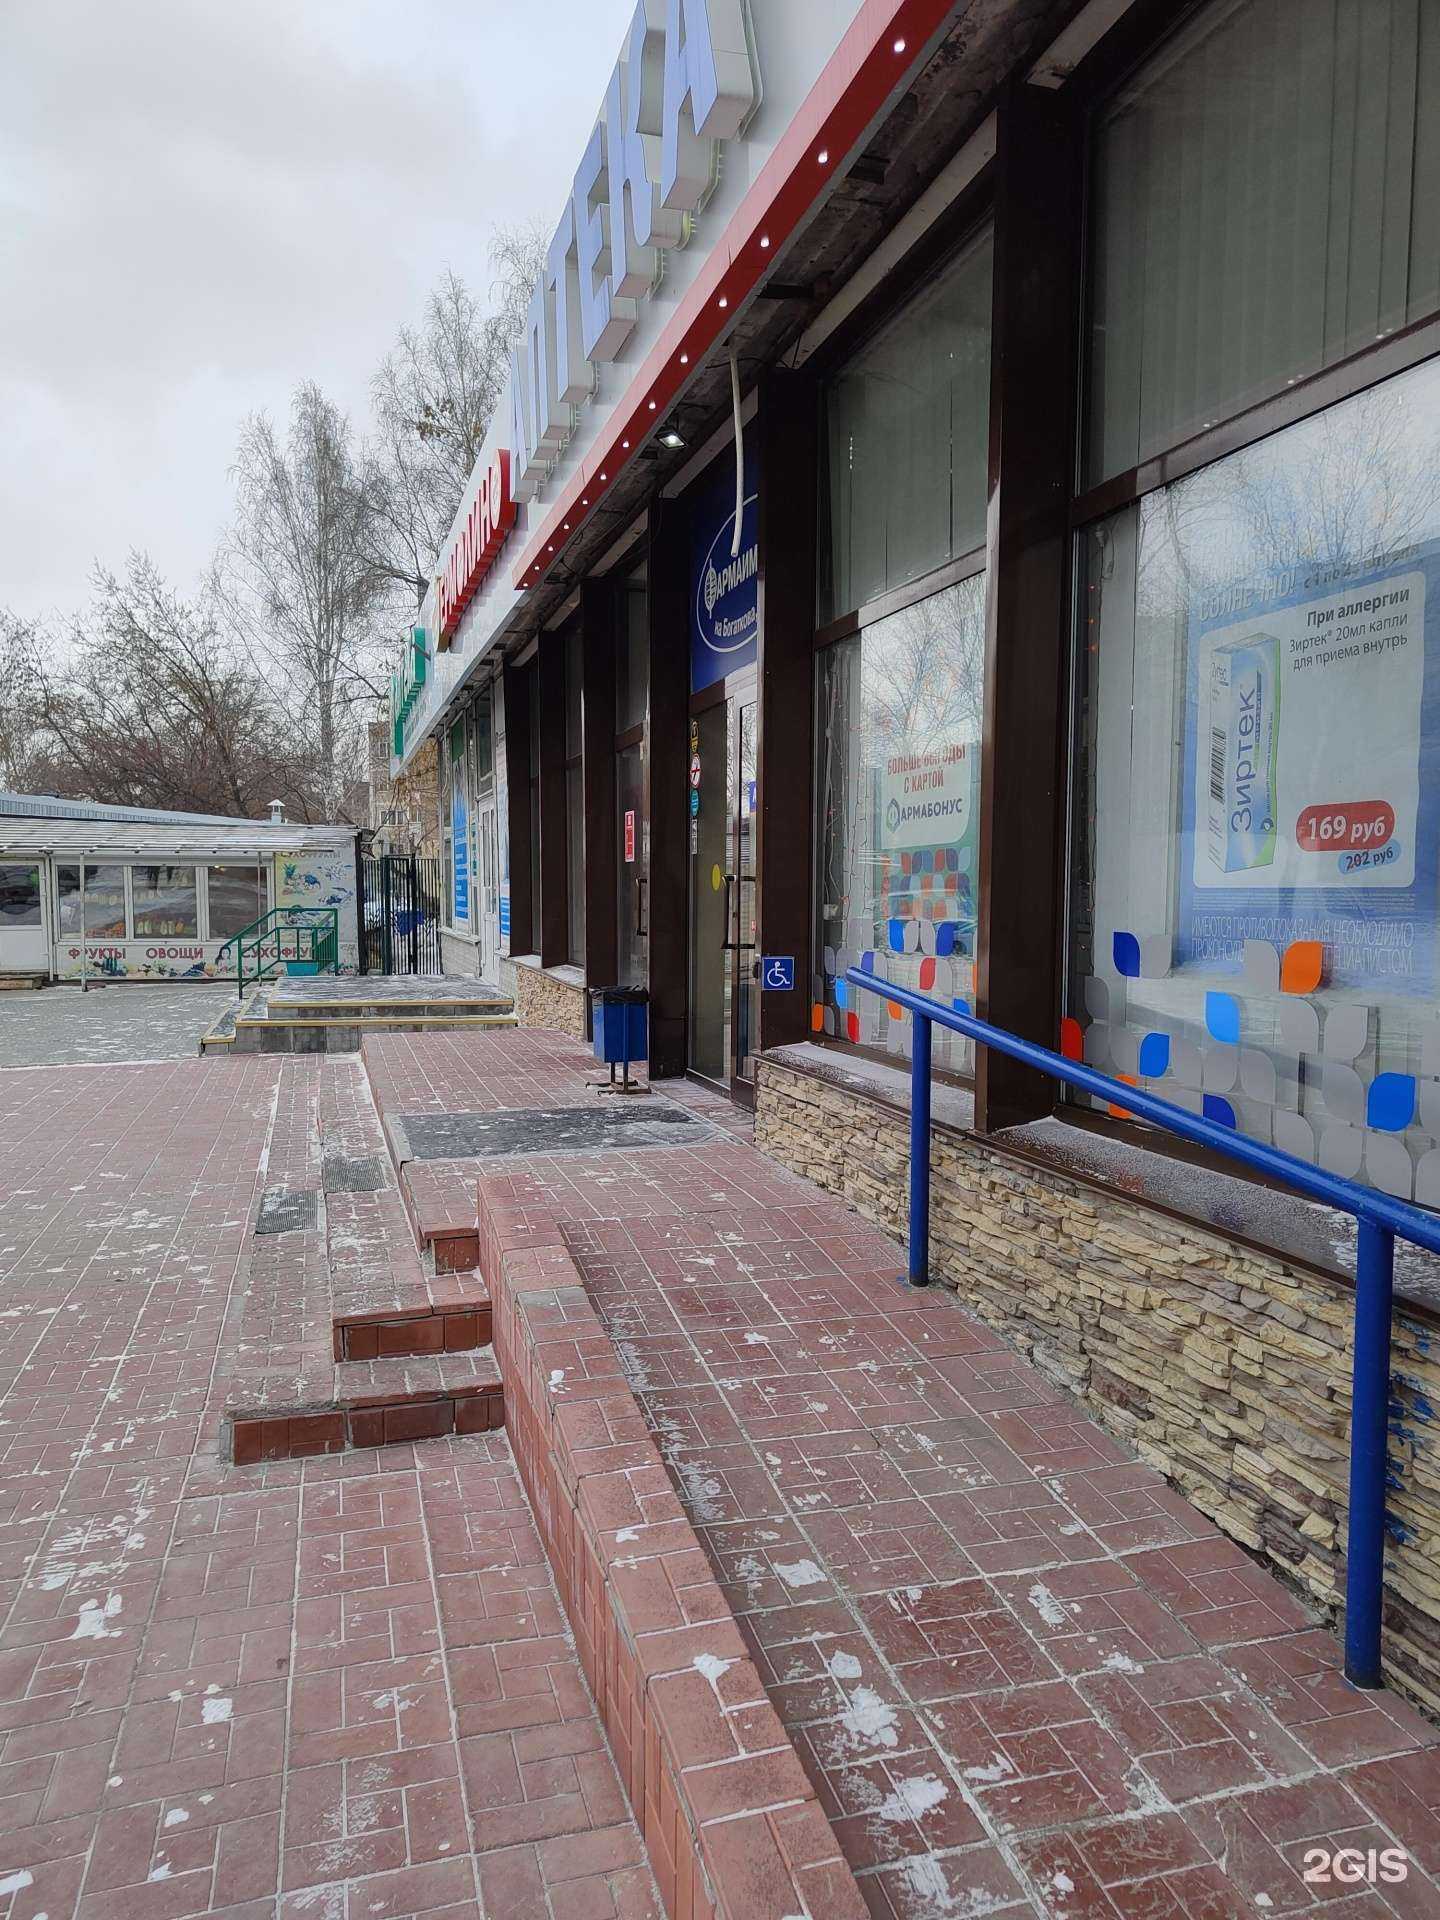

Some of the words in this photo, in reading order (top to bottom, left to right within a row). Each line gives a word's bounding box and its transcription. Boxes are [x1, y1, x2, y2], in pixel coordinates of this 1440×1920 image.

[509, 0, 722, 502] АПТЕКА
[704, 543, 758, 619] ФАРМАИМ
[1307, 608, 1334, 628] При
[1338, 589, 1410, 619] аллергии
[1336, 624, 1366, 641] 20мл
[1369, 613, 1408, 633] капли
[1293, 656, 1313, 672] для
[1315, 645, 1360, 667] приема
[1363, 634, 1408, 655] внутрь
[1231, 688, 1255, 832] Зиртек
[904, 776, 909, 794] С
[911, 768, 944, 793] КАРТОЙ
[1308, 815, 1347, 841] 169
[1350, 816, 1386, 844] руб
[1345, 851, 1371, 872] 202
[1373, 847, 1394, 865] руб
[145, 946, 204, 961] ОВОЩИ
